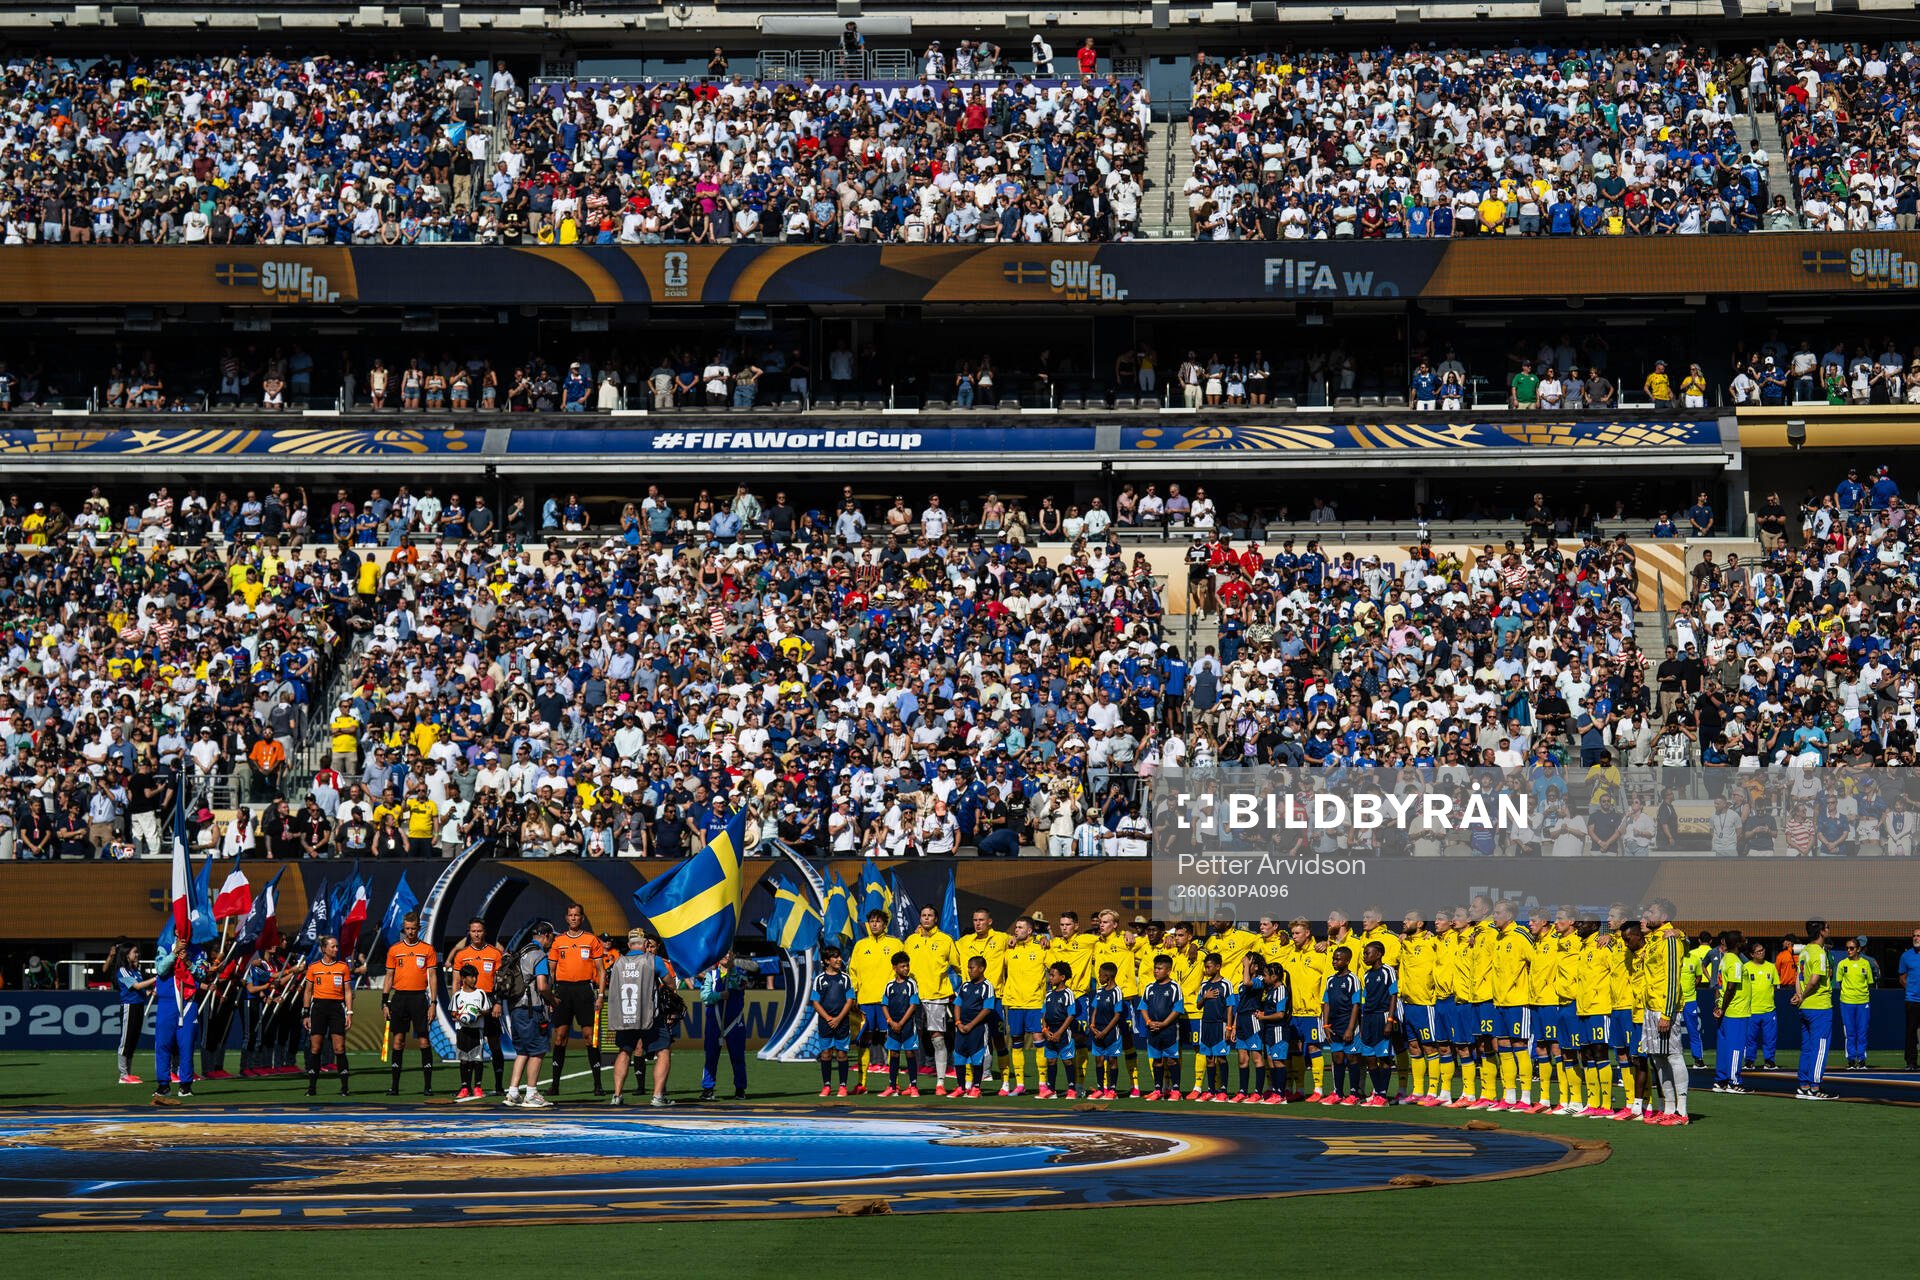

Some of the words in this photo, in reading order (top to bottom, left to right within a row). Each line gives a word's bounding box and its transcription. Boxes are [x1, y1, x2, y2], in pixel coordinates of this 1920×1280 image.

[1264, 258, 1337, 290] FIFA
[1849, 247, 1920, 288] SWED
[652, 431, 922, 450] #FIFAWorldCup
[1480, 1019, 1493, 1033] 25
[1513, 1022, 1521, 1035] 6
[1545, 1026, 1557, 1038] 21
[1419, 1028, 1431, 1041] 16
[1592, 1027, 1604, 1040] 13
